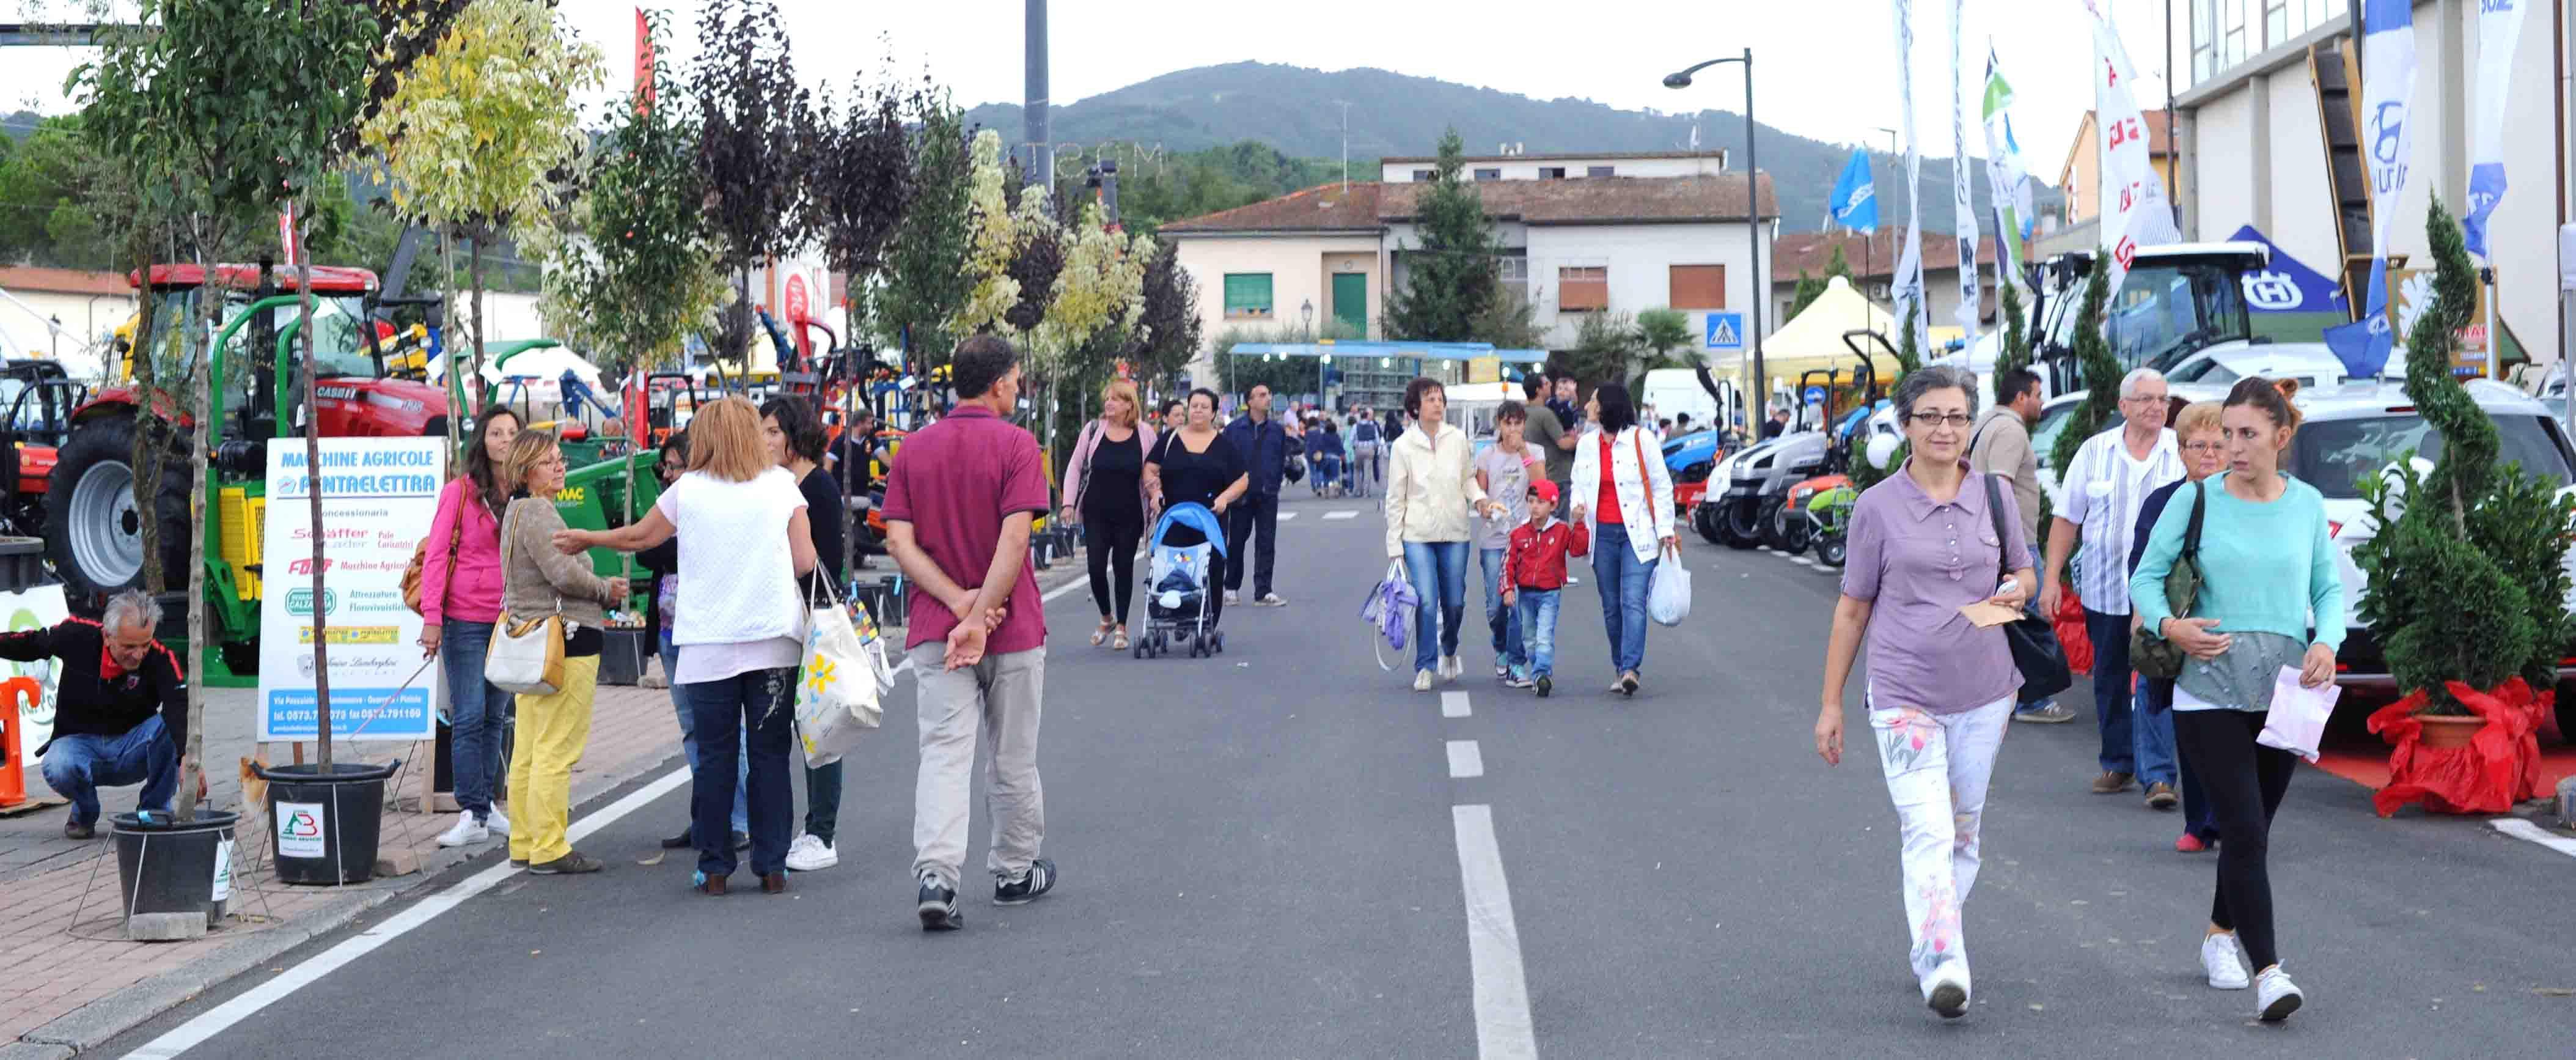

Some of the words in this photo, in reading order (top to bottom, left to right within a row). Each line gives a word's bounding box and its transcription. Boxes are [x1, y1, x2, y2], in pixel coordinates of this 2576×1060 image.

[362, 450, 433, 466] AGRICOLE
[299, 474, 435, 493] PNTAELETTRA
[321, 508, 389, 517] oncessionaria
[288, 557, 333, 575] FOT
